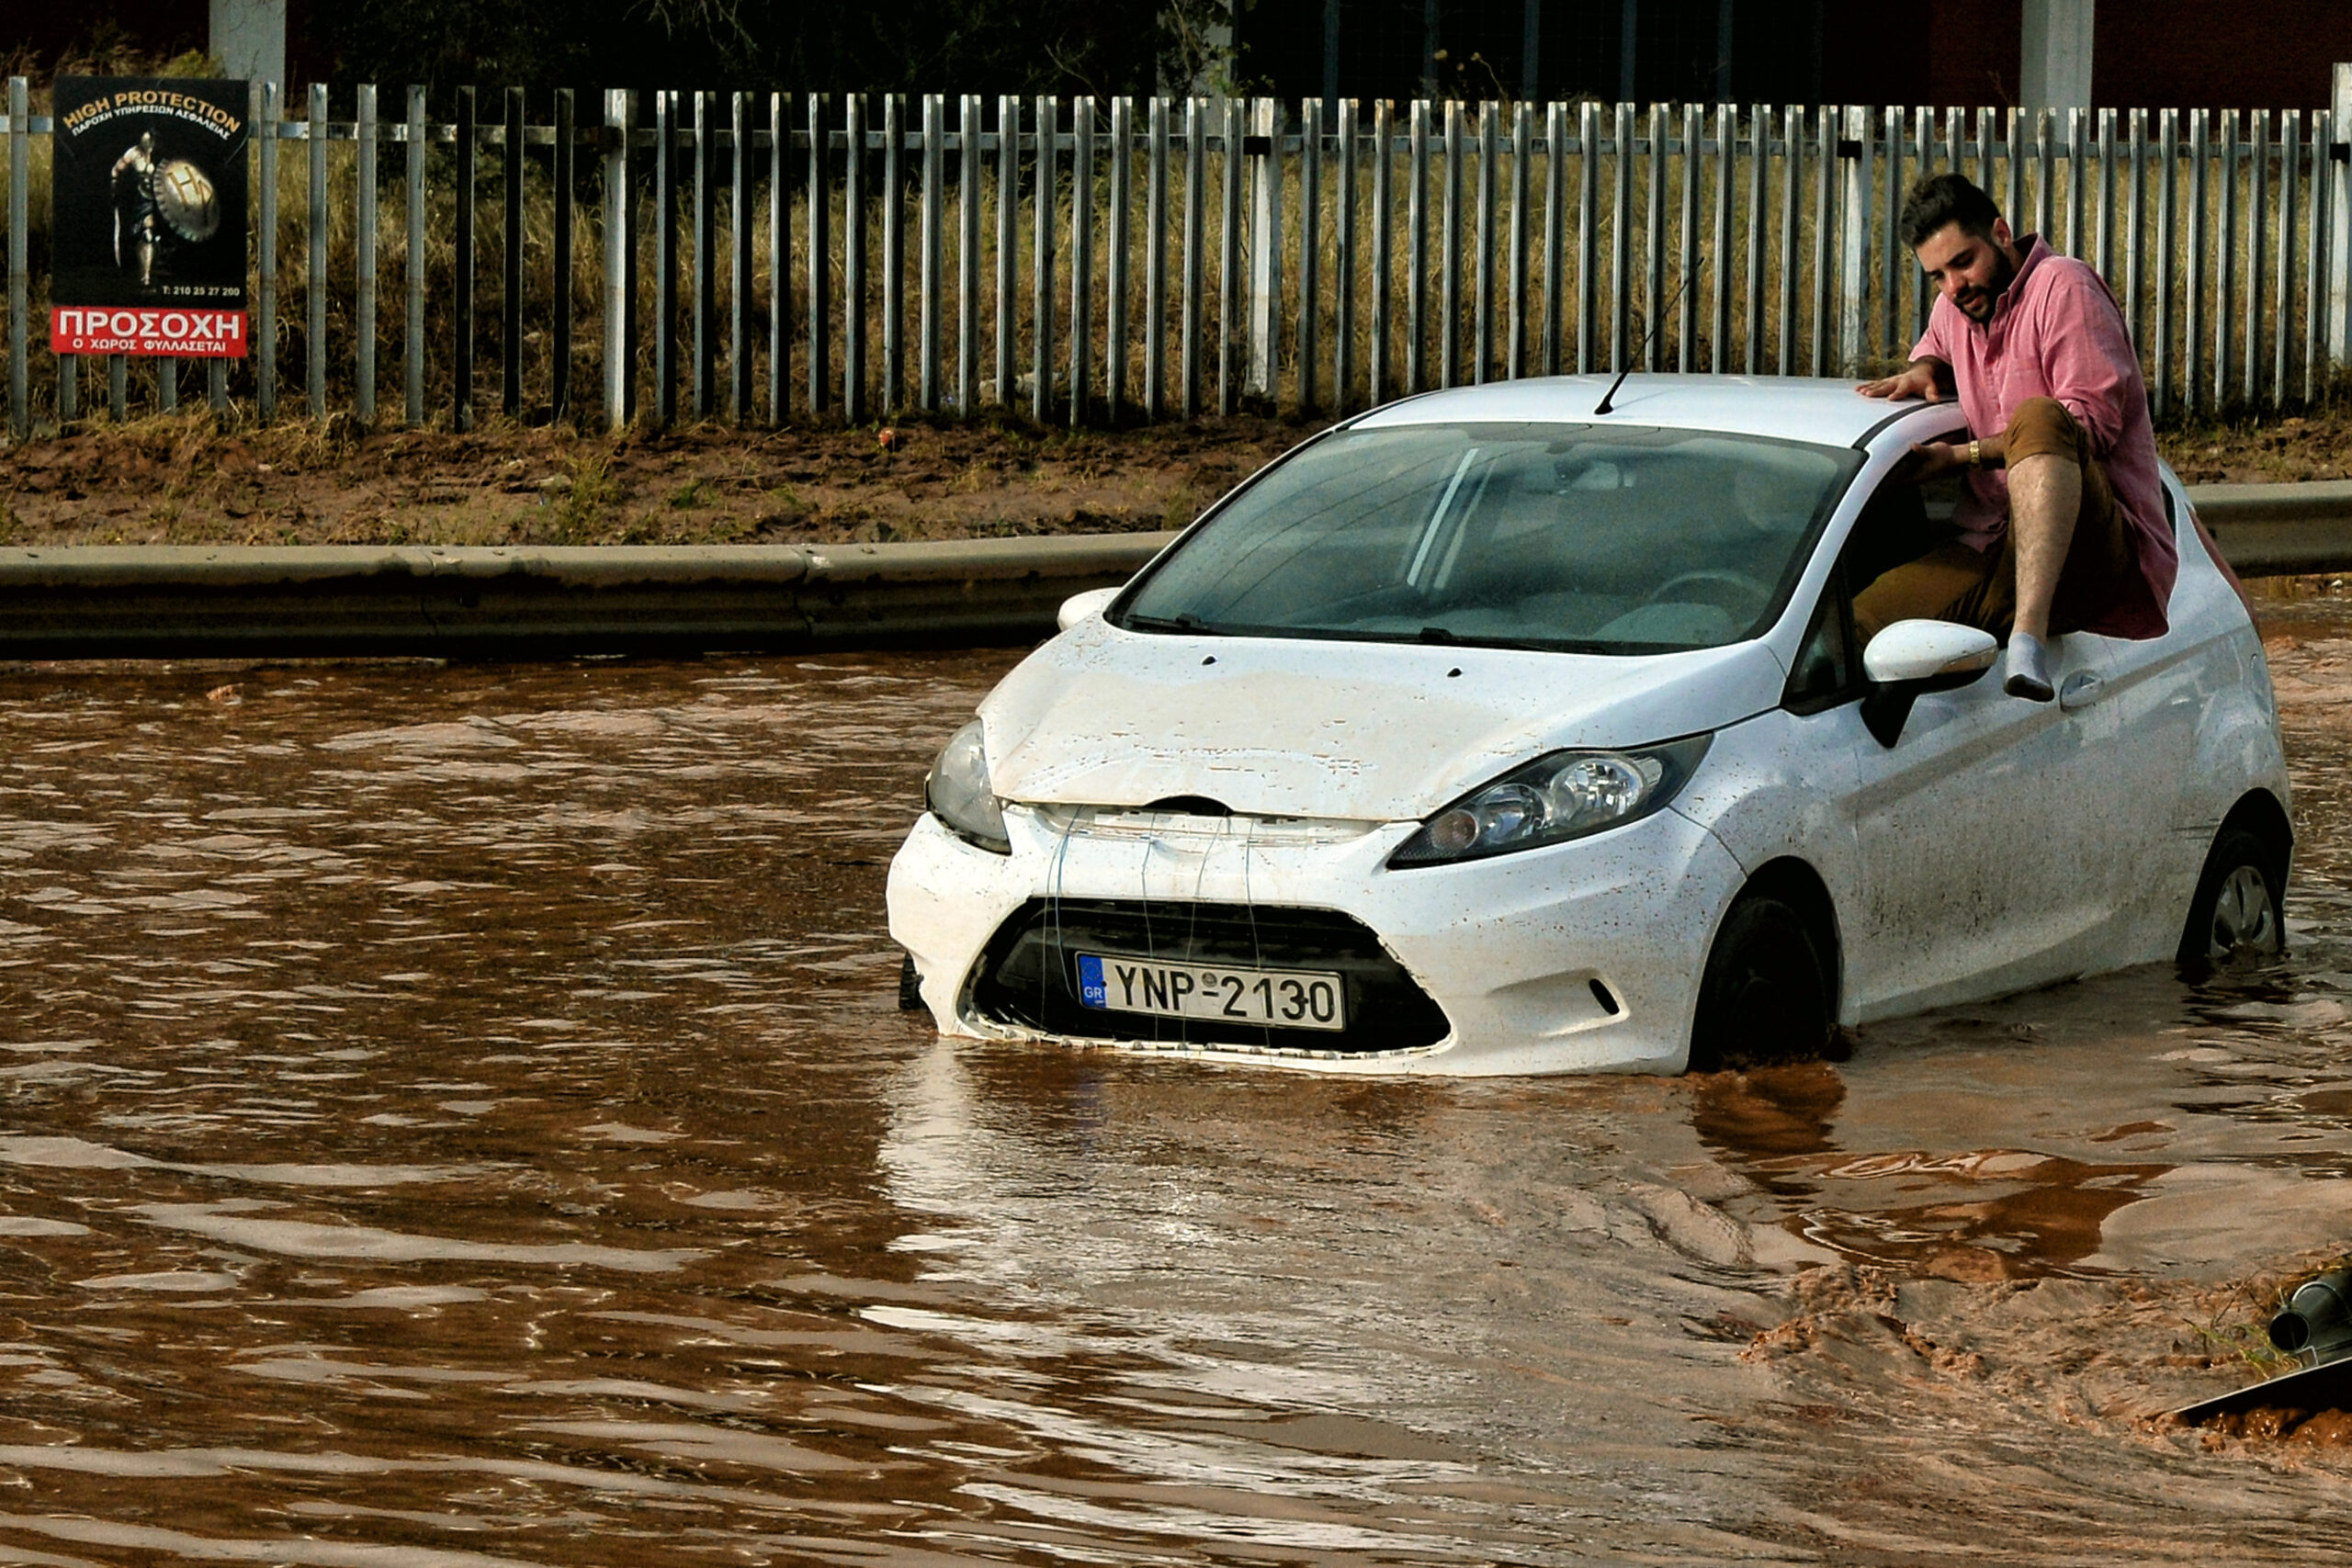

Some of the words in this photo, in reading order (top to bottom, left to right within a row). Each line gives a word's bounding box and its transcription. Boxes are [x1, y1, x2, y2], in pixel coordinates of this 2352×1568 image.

[62, 97, 110, 129] HIGH
[115, 90, 241, 133] PROTECTION
[72, 110, 113, 136] ΠΑΡΟΧΗ
[114, 105, 174, 117] ΥΠΗΡΕΣΙΩΝ
[175, 108, 231, 141] ΑΣΦΑΛΕΙΑΣ
[173, 286, 191, 295] 210
[208, 287, 220, 295] 27
[59, 310, 240, 339] ΠΡΟΣΟΧΗ
[73, 338, 84, 349] Ο
[90, 339, 137, 350] ΧΩΡΟΣ
[143, 340, 226, 352] ΦΥΛΛΑΣΕΤΑΙ
[1083, 986, 1103, 999] GR
[1114, 964, 1336, 1022] YNP-2130
